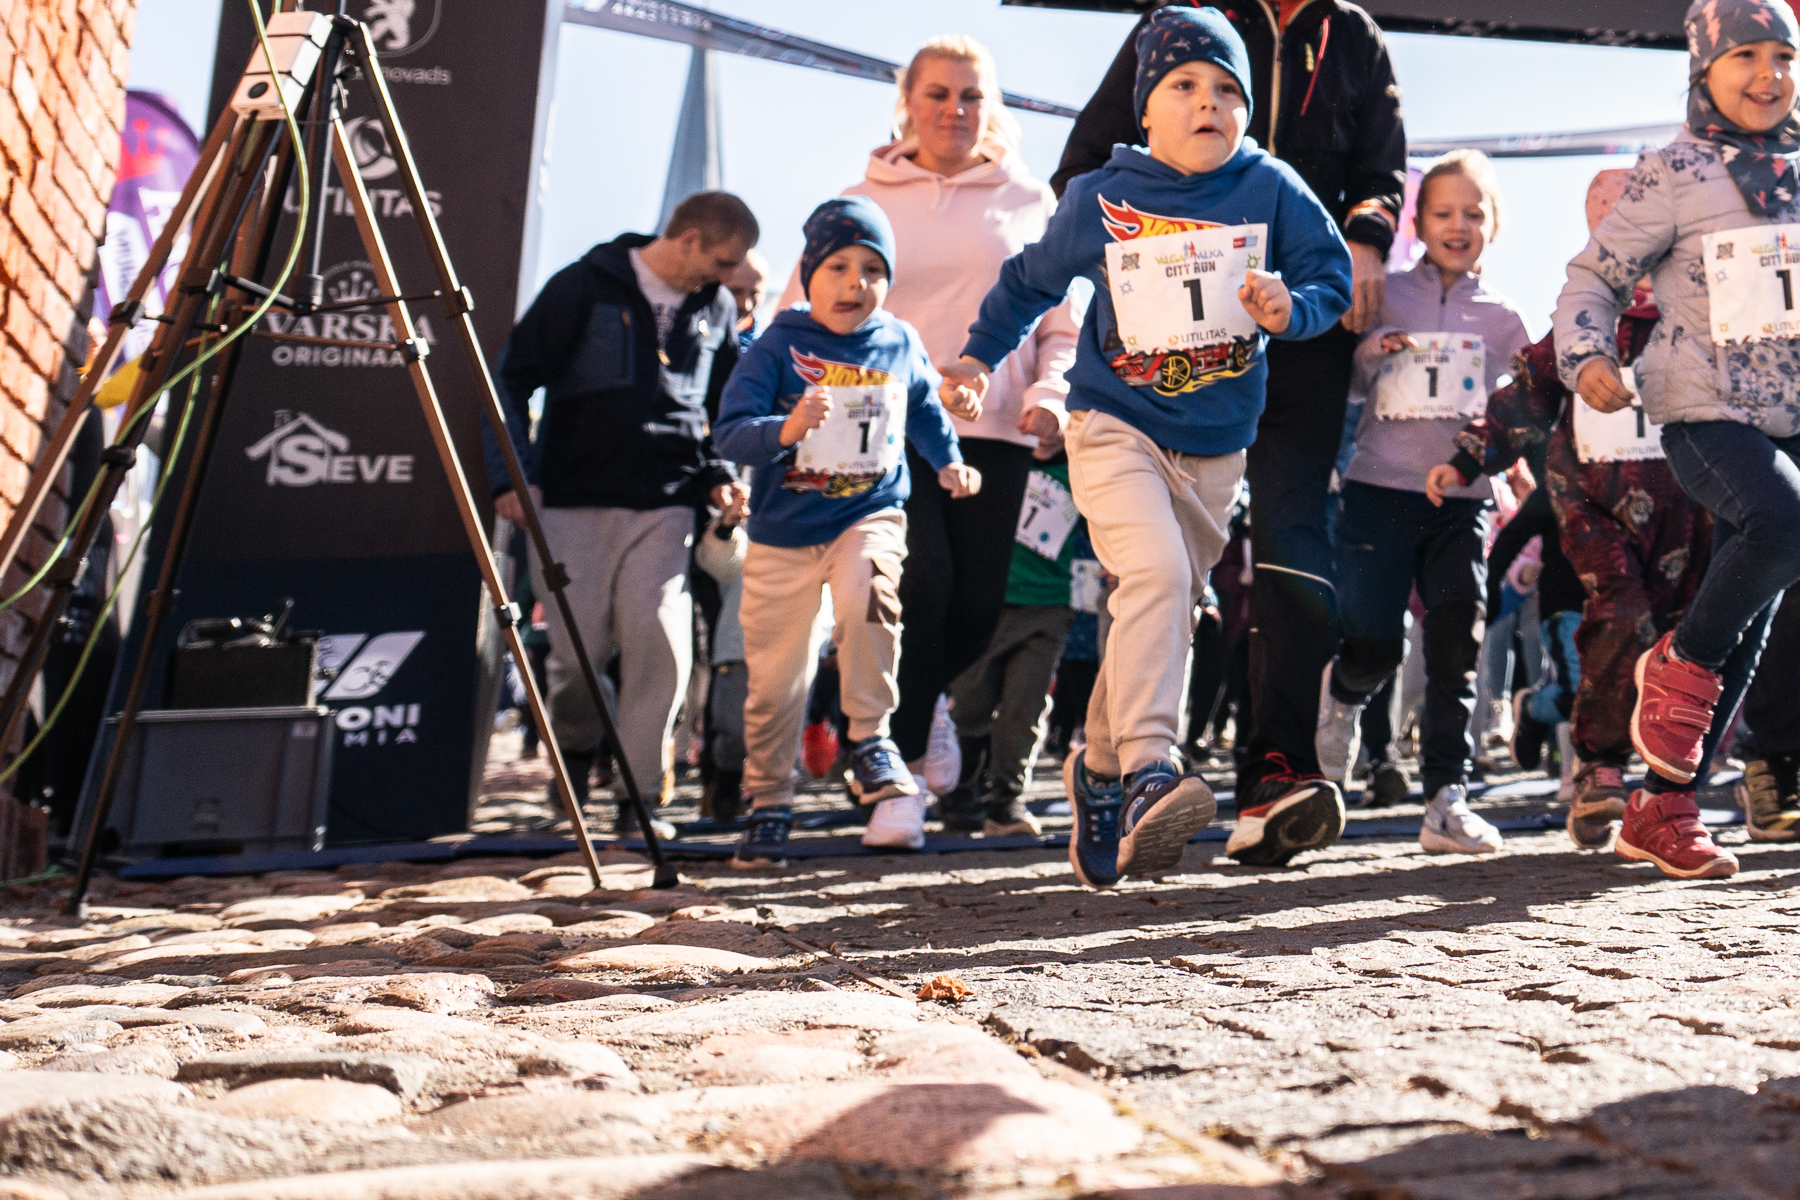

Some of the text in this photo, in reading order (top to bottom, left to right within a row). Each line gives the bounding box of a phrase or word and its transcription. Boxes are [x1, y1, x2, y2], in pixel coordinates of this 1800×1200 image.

[1165, 260, 1217, 278] CITY RUN
[1183, 278, 1205, 322] 1
[1776, 269, 1793, 311] 1
[1181, 327, 1228, 343] UTILITAS
[272, 346, 407, 368] ORIGINAA
[1426, 367, 1438, 398] 1
[859, 421, 871, 454] 1
[1632, 406, 1645, 438] 1
[274, 433, 414, 487] SEVE
[1023, 505, 1039, 530] 1
